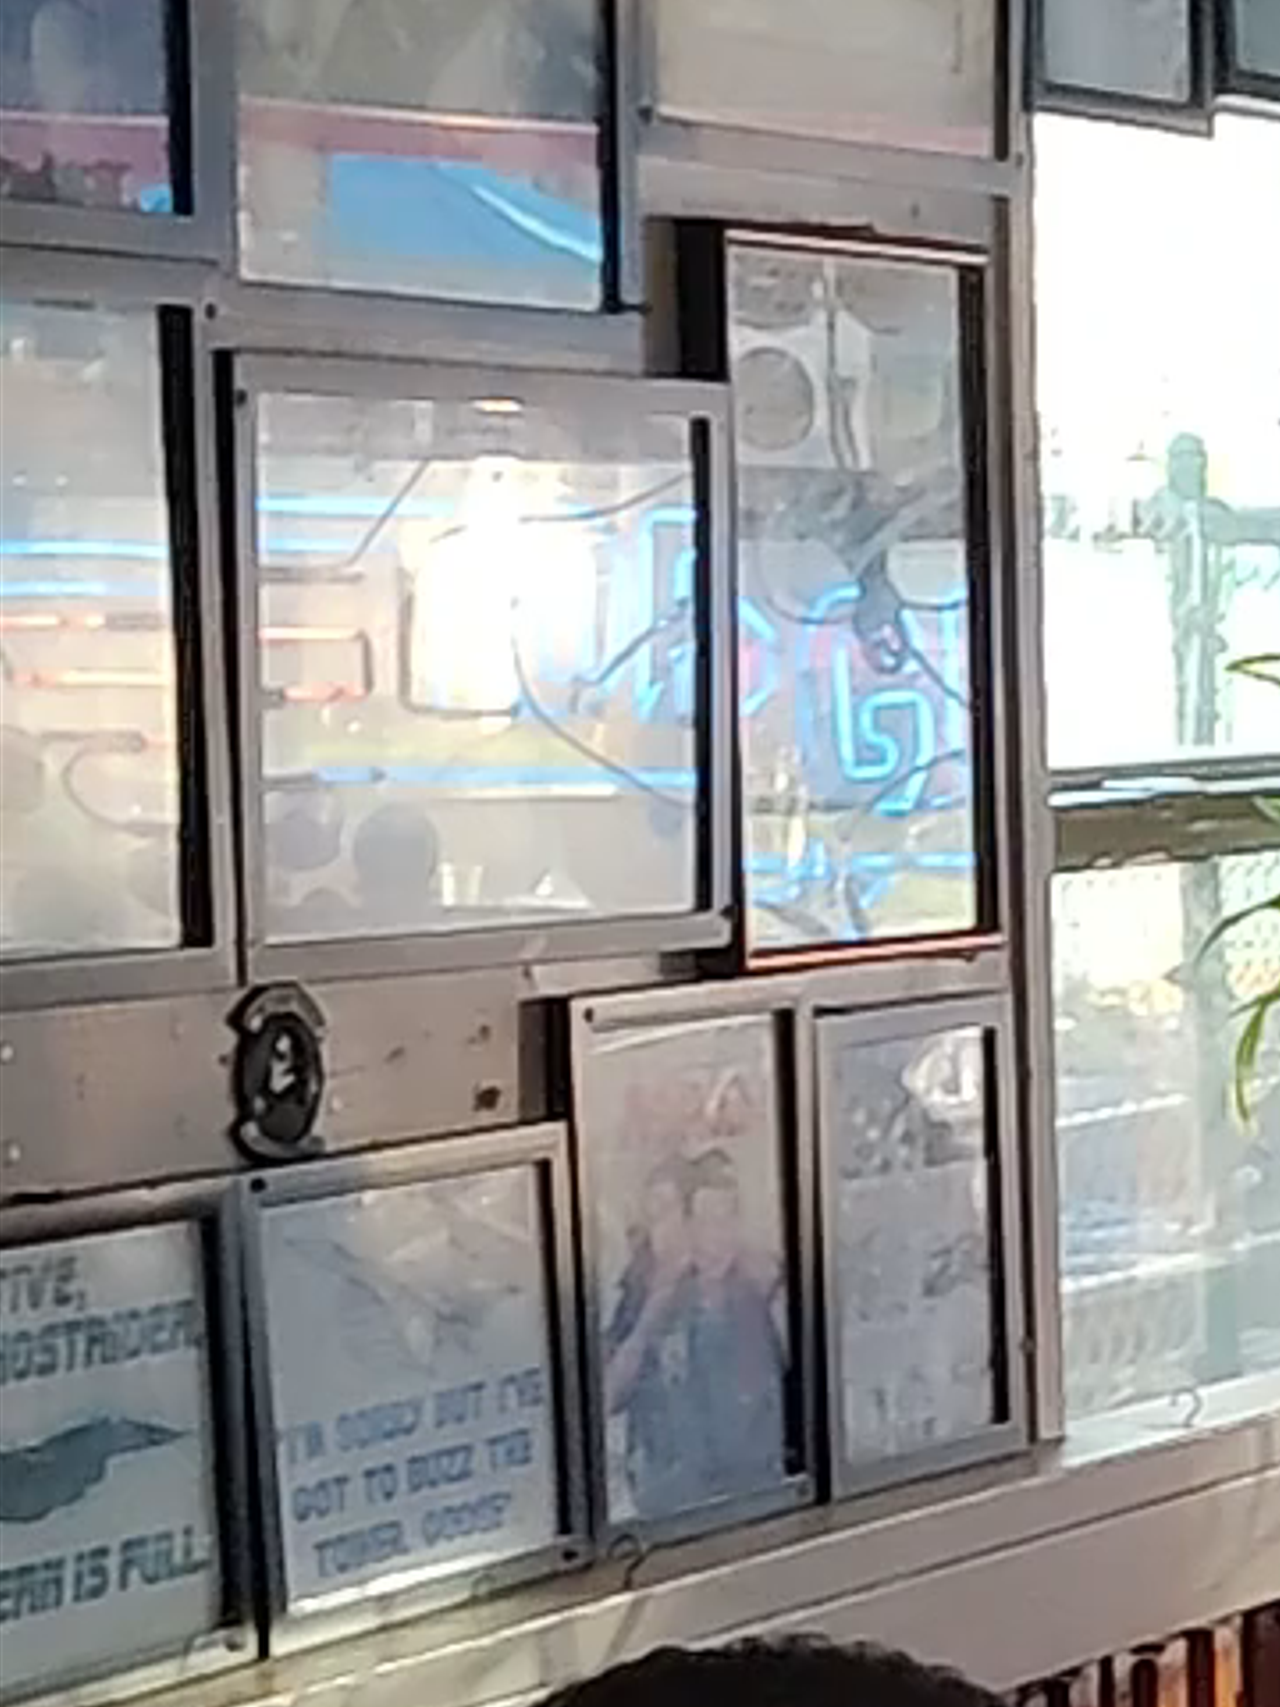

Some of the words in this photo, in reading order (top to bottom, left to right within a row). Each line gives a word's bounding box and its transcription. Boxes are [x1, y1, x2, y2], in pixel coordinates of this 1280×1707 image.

[293, 1475, 349, 1522] GOT
[363, 1463, 398, 1504] TO
[405, 1444, 476, 1492] BUZZ
[73, 1546, 110, 1603] IS
